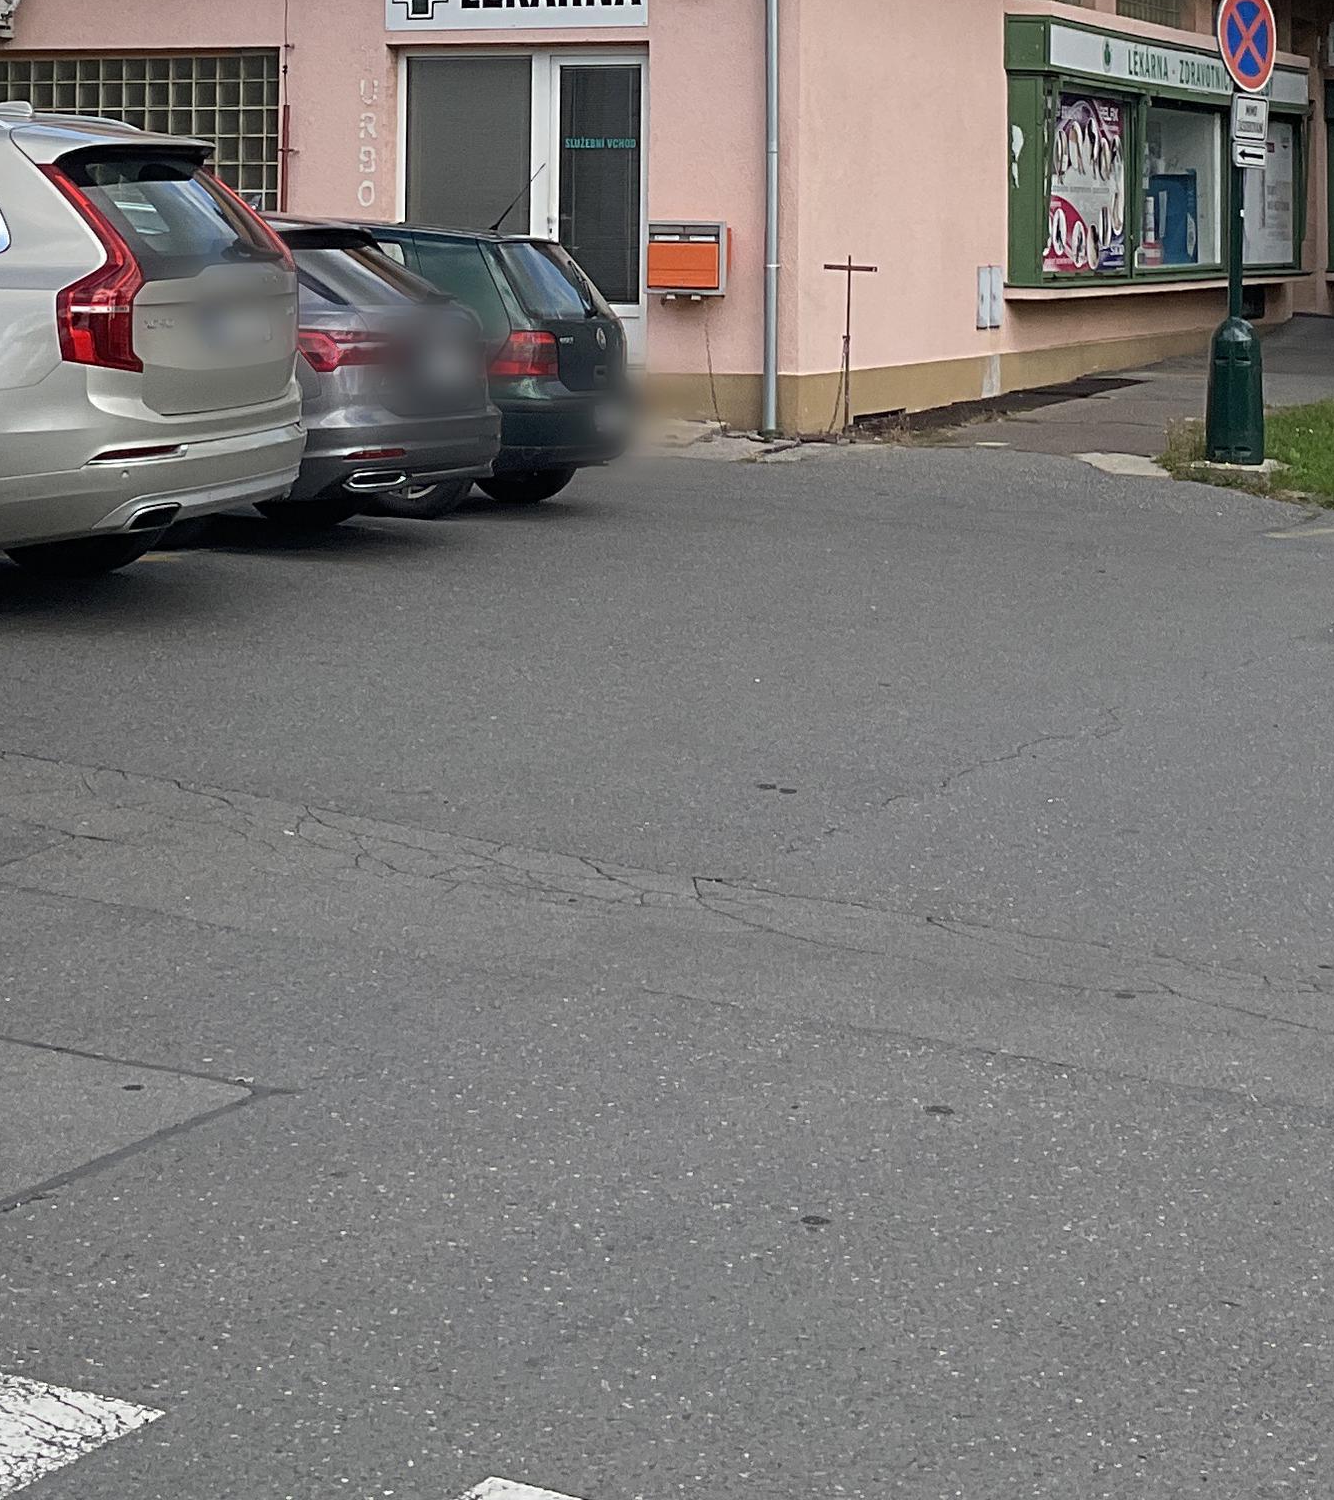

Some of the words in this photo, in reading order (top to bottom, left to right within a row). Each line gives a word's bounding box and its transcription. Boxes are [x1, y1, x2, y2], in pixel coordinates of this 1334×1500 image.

[1127, 44, 1169, 78] LÉKÁRNA
[565, 136, 605, 149] SLUŽEBNÍ
[607, 138, 637, 149] VCHOD
